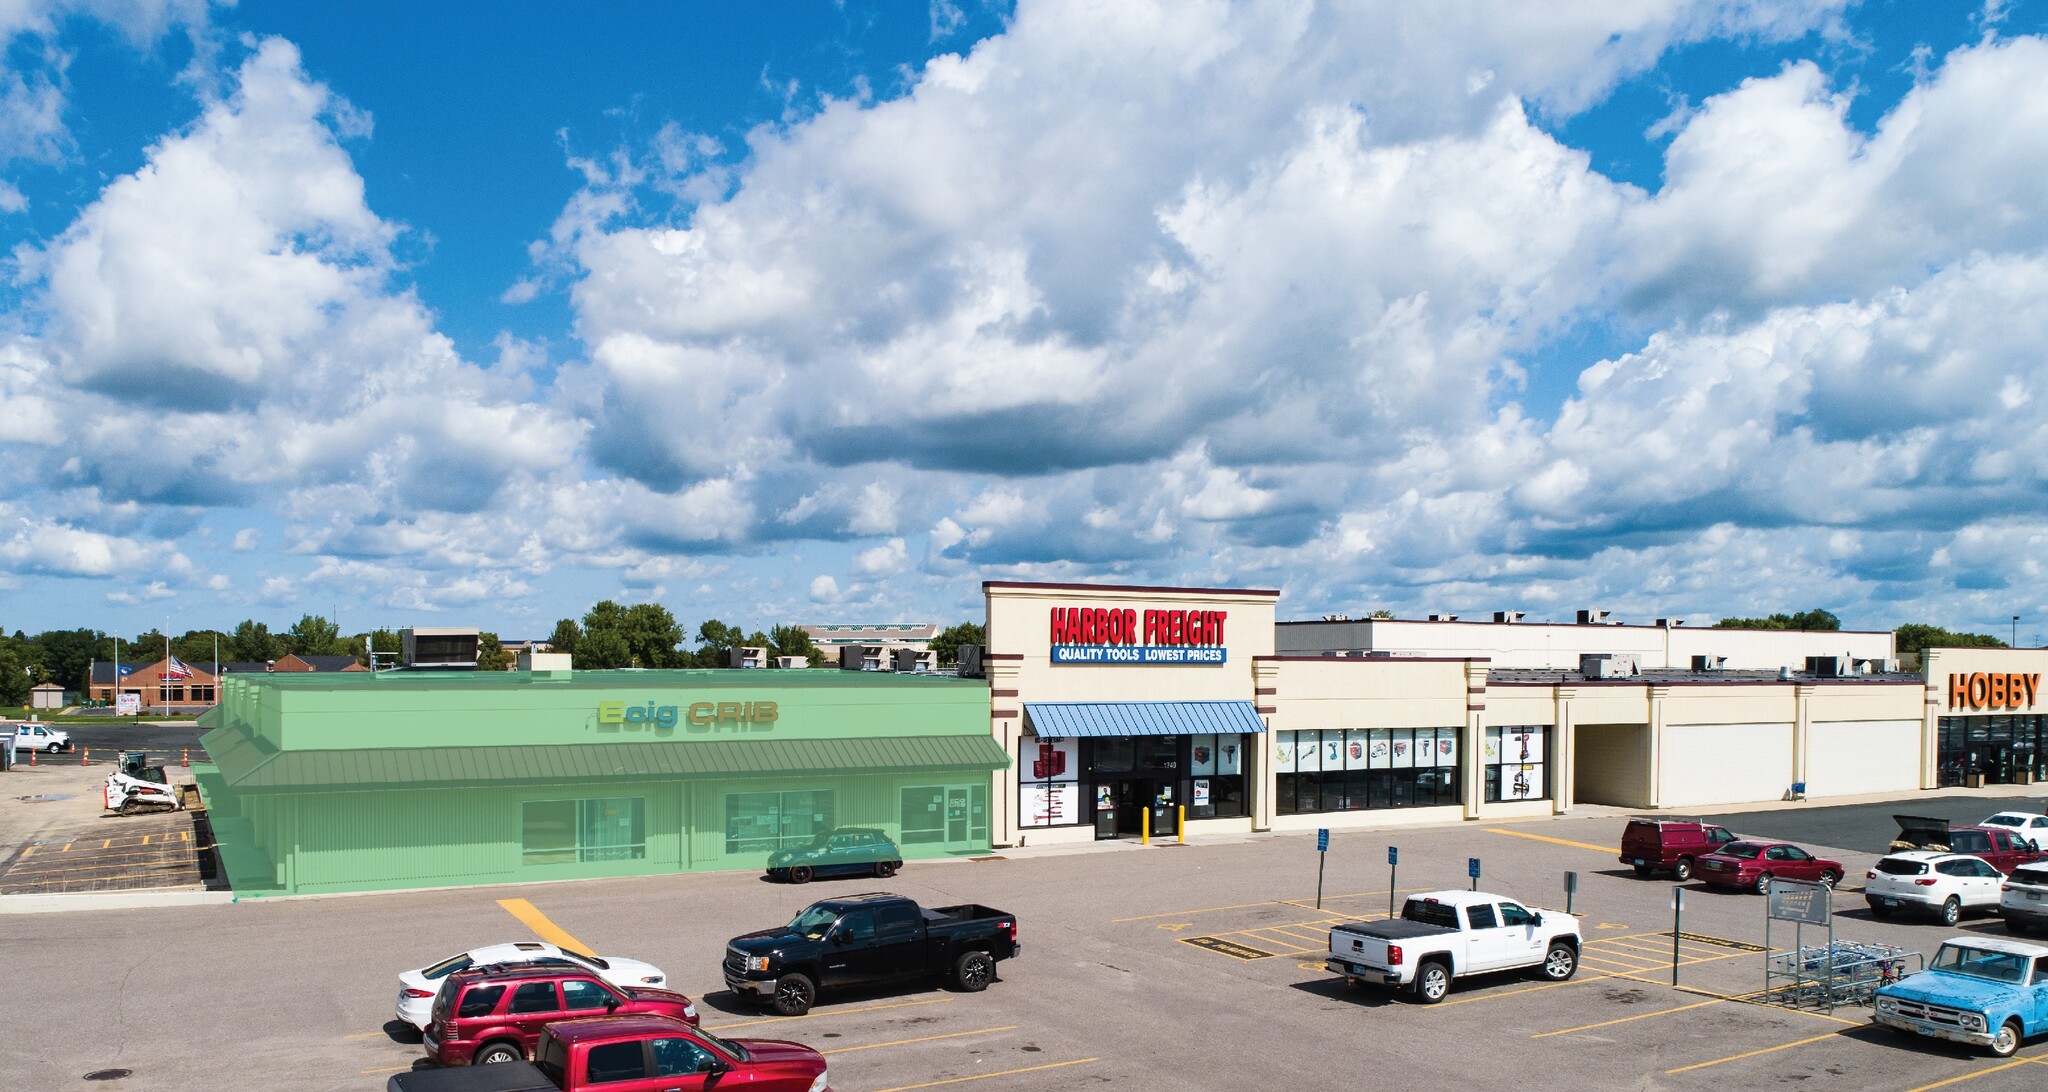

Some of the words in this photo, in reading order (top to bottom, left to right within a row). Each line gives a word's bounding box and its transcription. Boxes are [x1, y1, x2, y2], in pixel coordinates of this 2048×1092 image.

[1050, 607, 1137, 645] HARBOR
[1144, 609, 1227, 646] FREIGHT
[1059, 647, 1104, 661] QUALITY
[1106, 648, 1140, 661] TOOLS
[1145, 649, 1185, 661] LOWEST
[1187, 650, 1222, 661] PRICES
[1949, 672, 2041, 709] HOBBY
[597, 700, 678, 728] Ecig
[688, 701, 779, 724] CRIB
[1914, 1009, 1938, 1017] GMC
